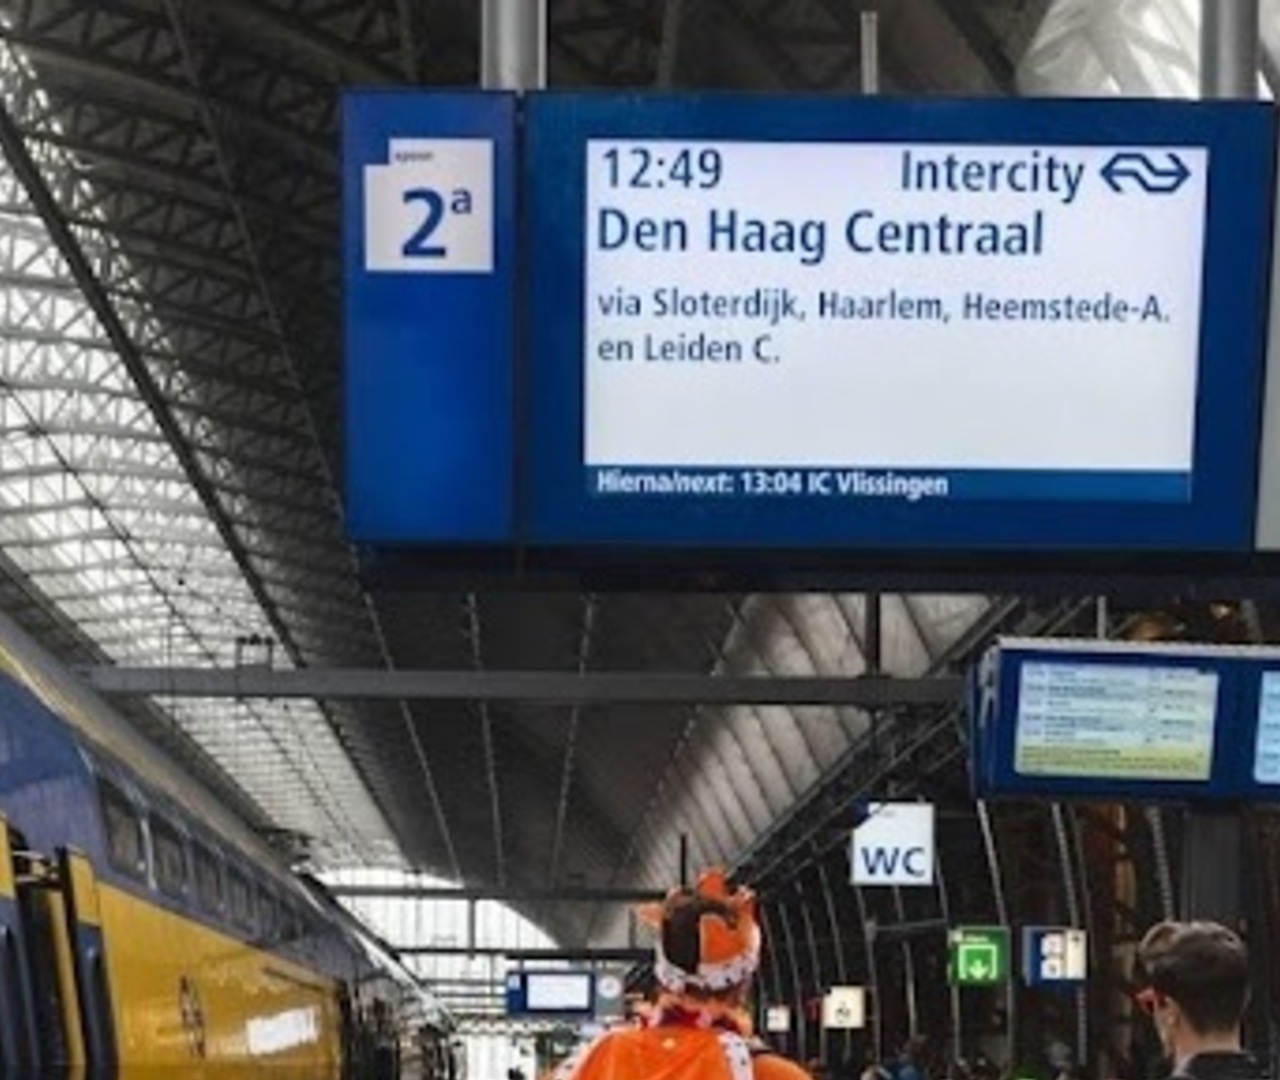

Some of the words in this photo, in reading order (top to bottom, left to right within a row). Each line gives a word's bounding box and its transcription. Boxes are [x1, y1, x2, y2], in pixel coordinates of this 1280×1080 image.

[602, 148, 723, 190] 12:49
[901, 149, 1086, 204] Intercity
[402, 187, 472, 257] 2a
[597, 207, 689, 252] Den
[708, 208, 828, 266] Haag
[844, 209, 1044, 257] Centraal
[596, 288, 643, 318] via
[652, 287, 807, 327] Sloterdijk,
[818, 289, 950, 324] Haarlem,
[963, 291, 1172, 323] Heemstede-A.
[596, 338, 636, 363] en
[644, 332, 743, 363] Leiden
[752, 333, 781, 364] C.
[596, 468, 735, 495] Hierna/next:
[740, 470, 803, 495] 13:04
[808, 471, 831, 495] IC
[836, 470, 950, 500] Vlissingen
[860, 846, 926, 877] WC
